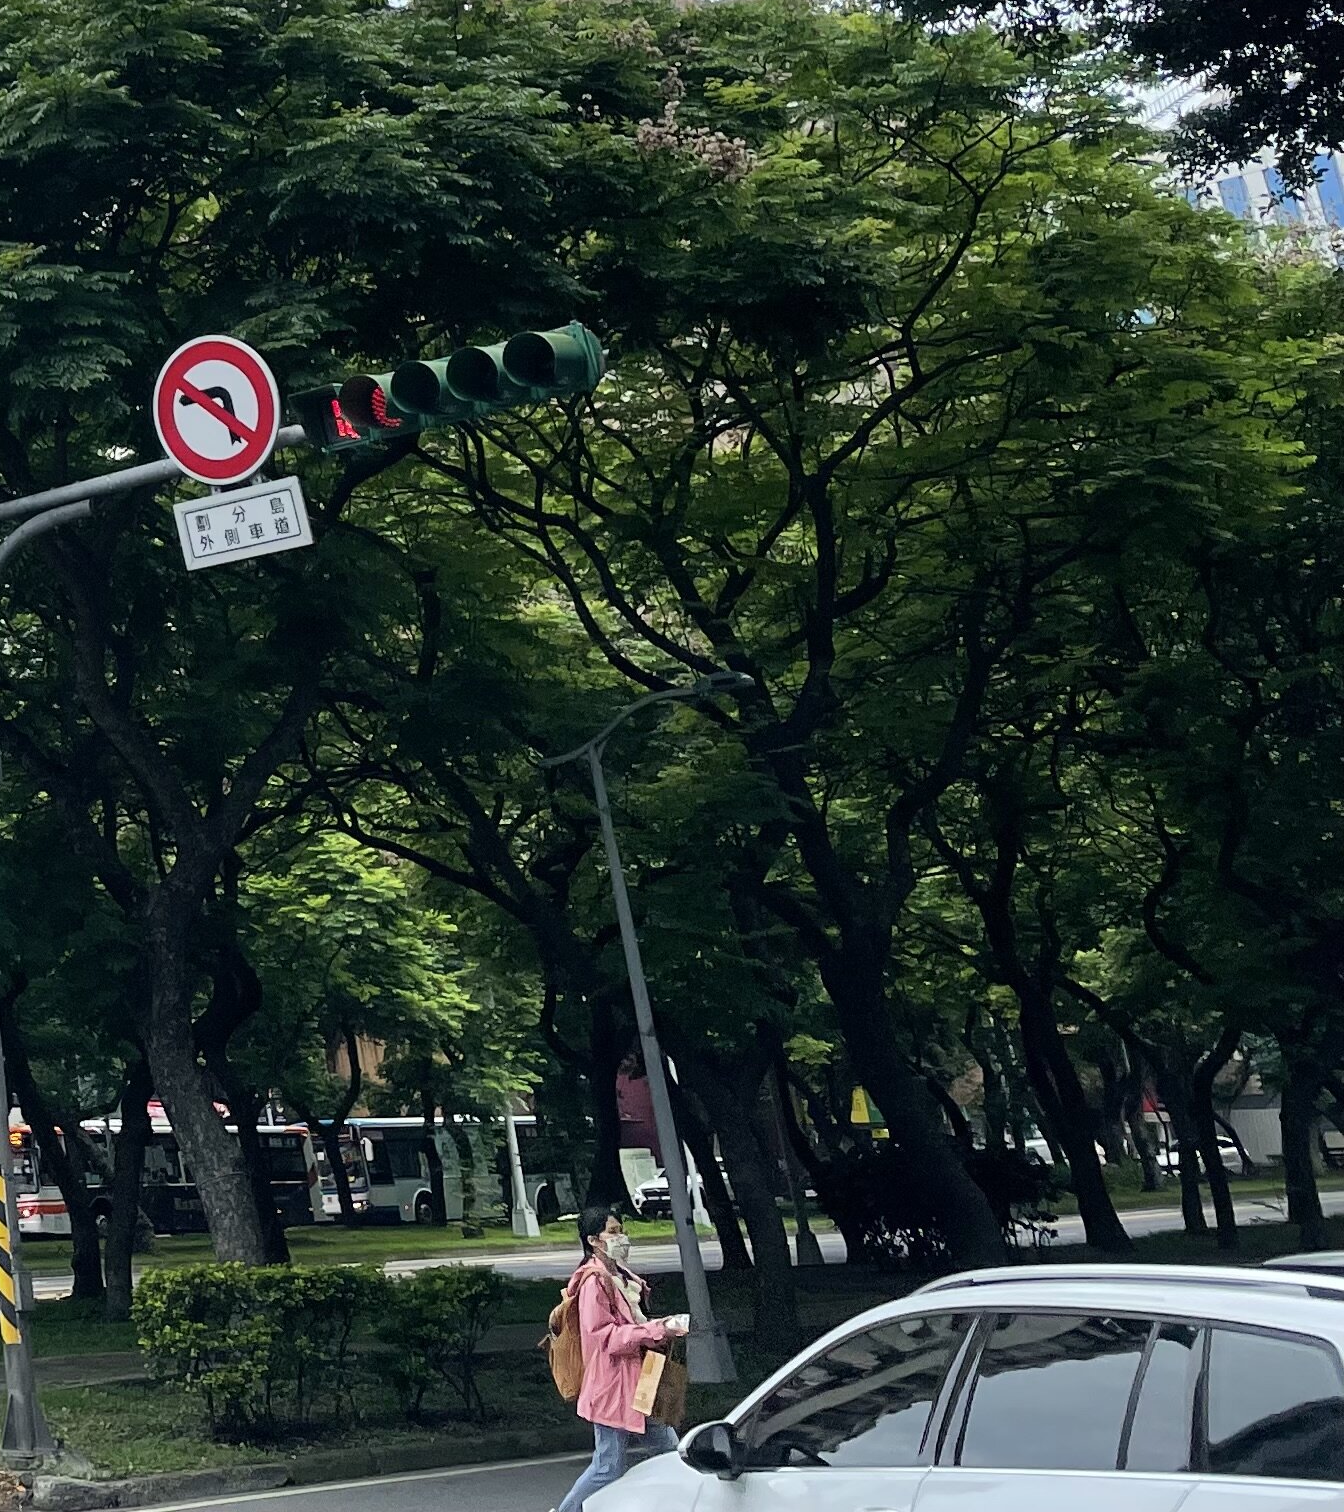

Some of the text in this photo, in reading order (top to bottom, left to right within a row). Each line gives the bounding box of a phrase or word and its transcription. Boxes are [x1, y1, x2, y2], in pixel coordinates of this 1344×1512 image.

[196, 497, 285, 532] 劃分島
[200, 517, 290, 552] 外側車道
